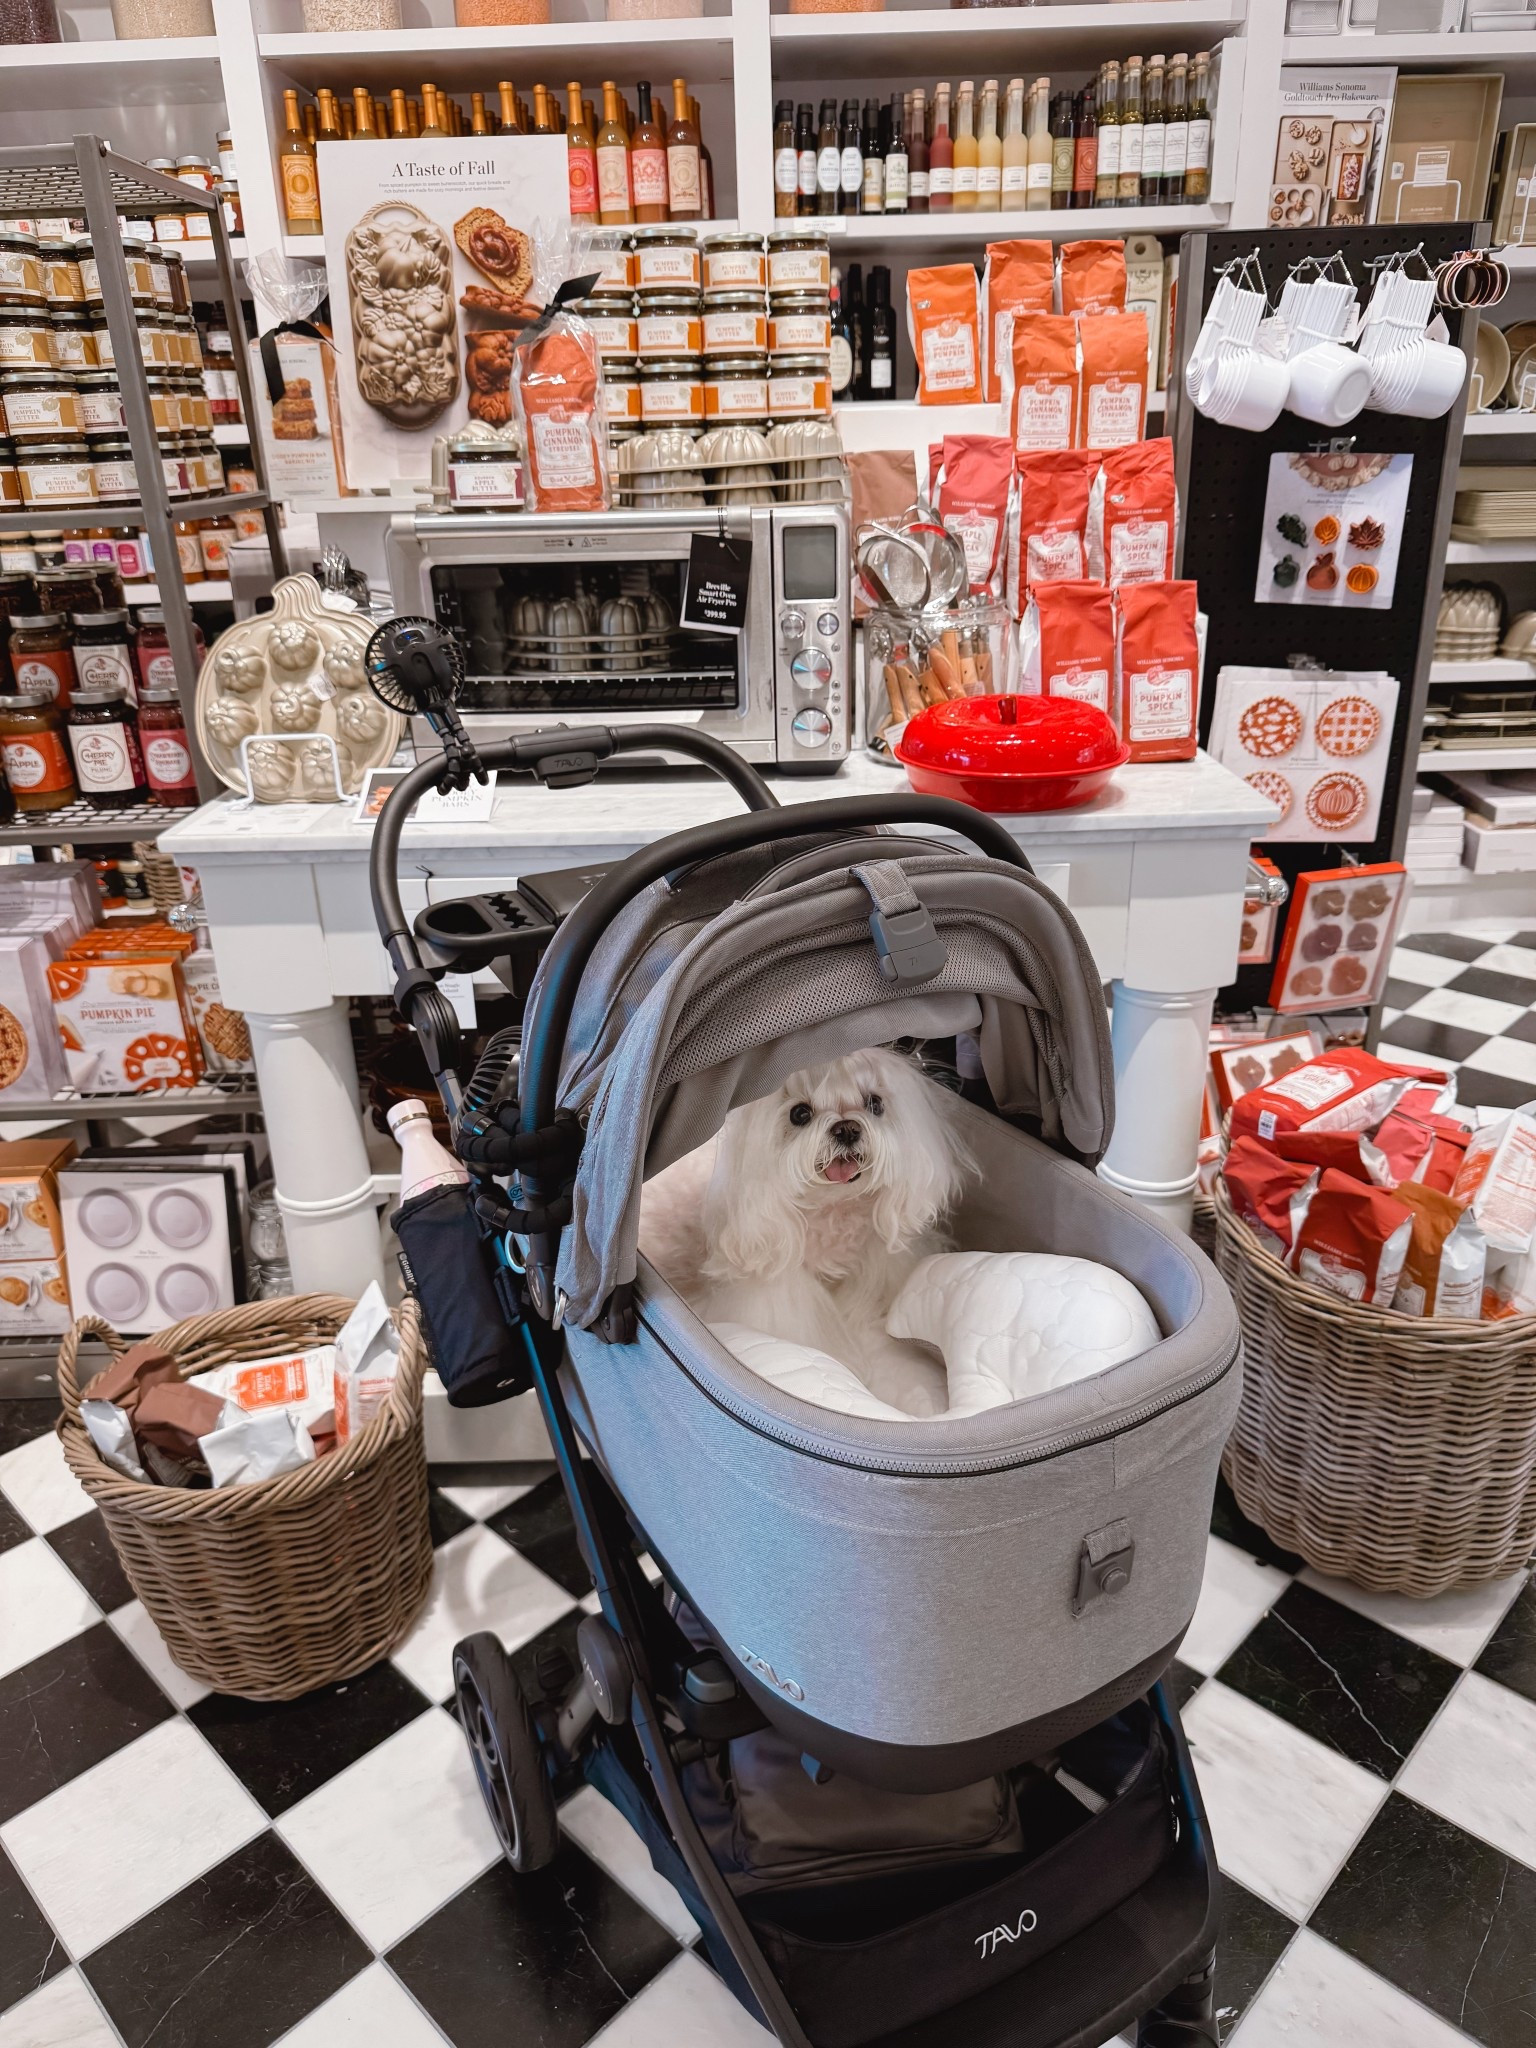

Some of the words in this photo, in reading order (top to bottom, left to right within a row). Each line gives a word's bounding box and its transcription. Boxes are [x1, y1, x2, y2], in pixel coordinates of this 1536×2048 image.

[1300, 82, 1334, 91] Williams
[1335, 82, 1366, 91] Sonoma
[1284, 92, 1324, 102] Goldtouch
[1326, 93, 1340, 101] Pro
[392, 163, 403, 177] A
[406, 162, 445, 177] Taste
[449, 161, 464, 175] of
[468, 160, 495, 174] Fall
[933, 350, 965, 358] PUMPKIN
[1027, 406, 1062, 414] CINNAMON
[1098, 404, 1132, 413] CINNAMON
[545, 428, 581, 437] PUMPKIN
[543, 437, 584, 447] CINNAMON
[962, 531, 982, 540] APLE
[1120, 543, 1158, 551] PUMPKIN
[1037, 553, 1074, 563] PUMPKIN
[1127, 552, 1150, 560] SPICE
[1043, 562, 1067, 570] SPICE
[706, 582, 731, 591] Breville
[699, 589, 718, 597] Smart
[719, 590, 736, 599] Oven
[708, 597, 725, 605] Fryer
[726, 599, 737, 607] Pro
[85, 669, 120, 681] CHERRY
[22, 678, 55, 689] APPLE
[1140, 694, 1182, 703] PUMPKIN
[1148, 702, 1174, 711] SPICE
[81, 749, 115, 763] CHERRY
[10, 758, 40, 769] APPLE
[554, 757, 584, 768] TAVO
[80, 1008, 133, 1020] PUMPKIN
[136, 1007, 155, 1017] PIE
[1314, 1239, 1341, 1255] WILLIAMS
[740, 1644, 804, 1702] TAVO
[974, 1909, 1037, 1959] TAVO
